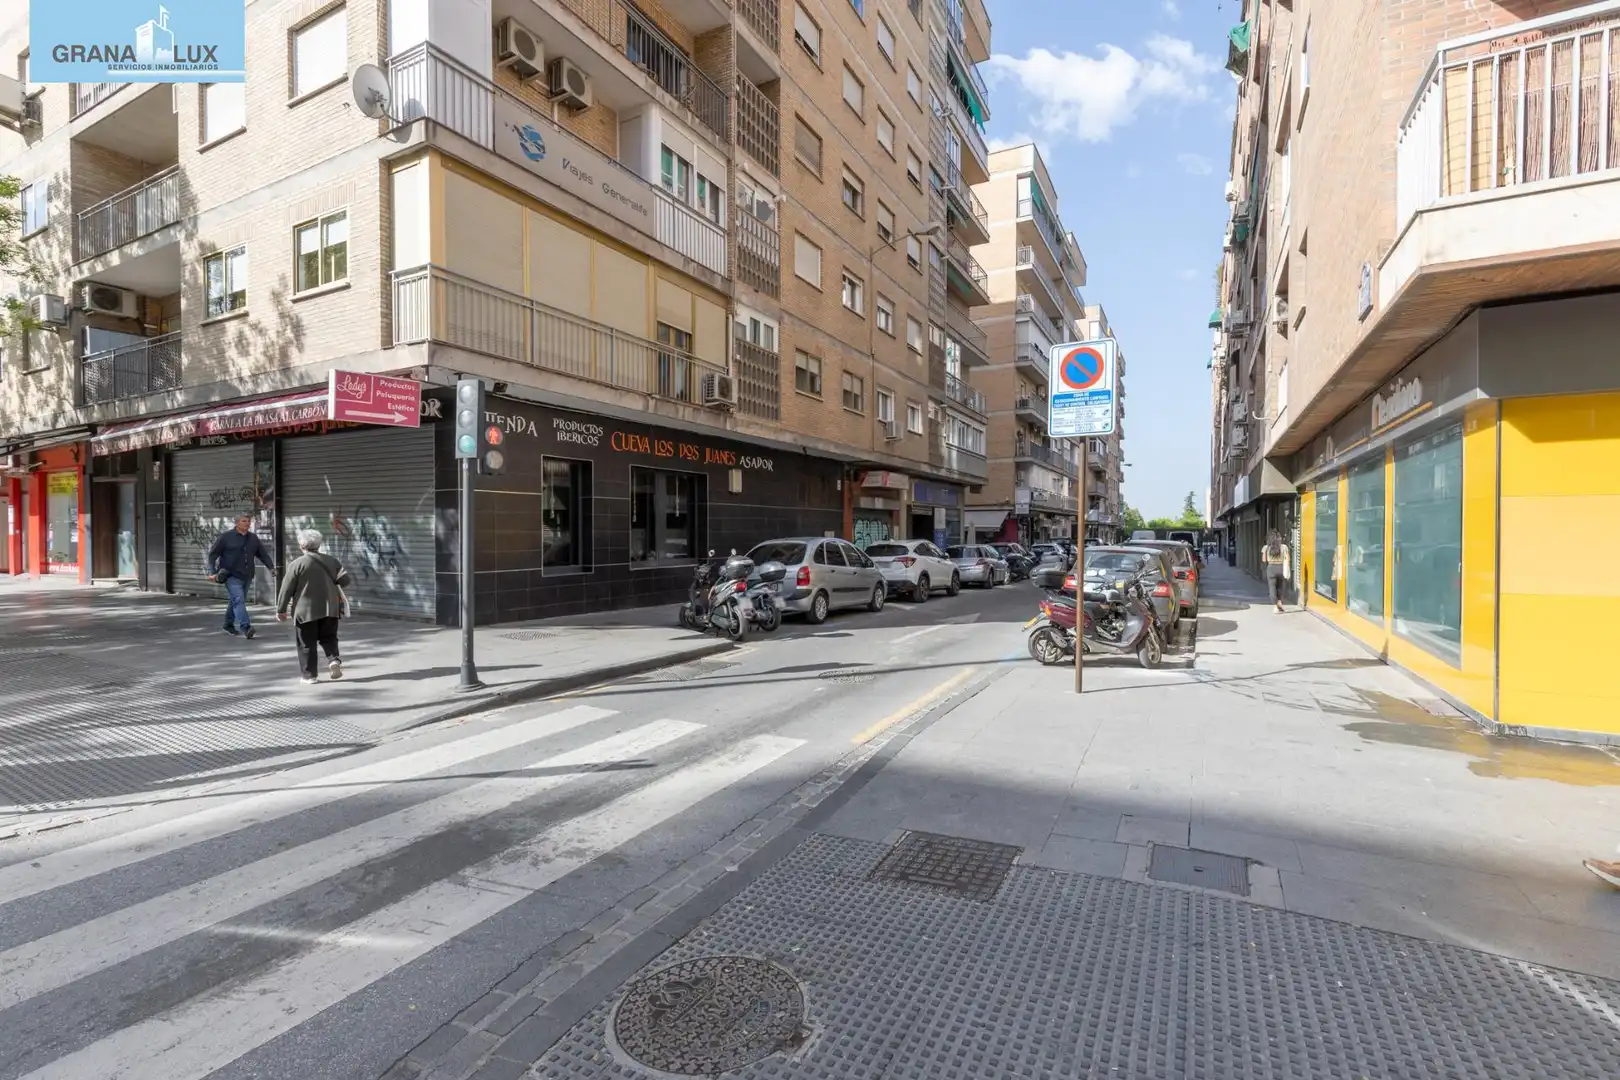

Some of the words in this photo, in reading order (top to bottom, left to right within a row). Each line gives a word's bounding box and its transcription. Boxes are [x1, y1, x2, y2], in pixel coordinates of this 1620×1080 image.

[562, 158, 593, 185] Viajes
[602, 182, 648, 216] Generalife
[380, 379, 416, 391] Productos
[243, 415, 253, 427] LA
[254, 411, 279, 426] BRASA
[279, 410, 291, 422] AL
[484, 411, 538, 437] TIENDA
[552, 417, 604, 437] PRODUCTOS
[557, 431, 599, 446] IBERICOS
[611, 431, 650, 453] CUEVA
[654, 439, 674, 457] LOS
[679, 443, 699, 461] DOS
[703, 447, 736, 466] JUANES
[739, 455, 774, 472] ASADOR
